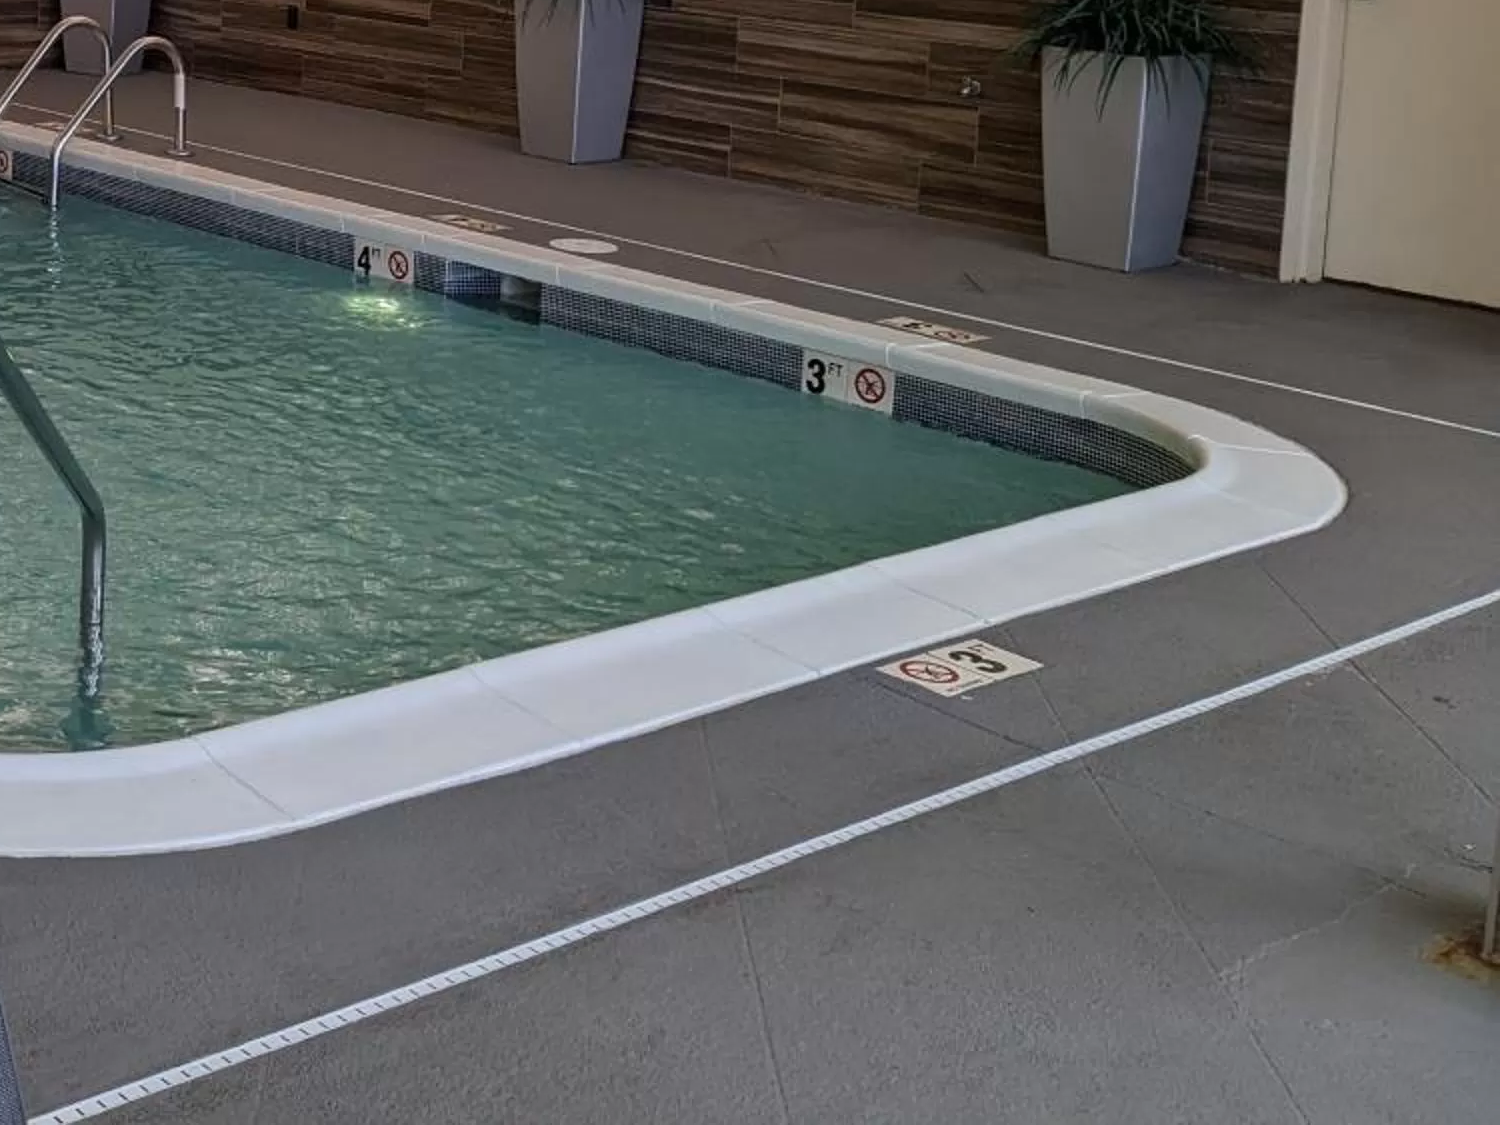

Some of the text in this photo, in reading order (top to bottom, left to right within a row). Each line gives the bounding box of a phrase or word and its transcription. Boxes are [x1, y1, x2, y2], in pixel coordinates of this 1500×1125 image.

[357, 245, 371, 276] 4
[806, 358, 844, 394] 3 FT
[948, 650, 1007, 674] 3
